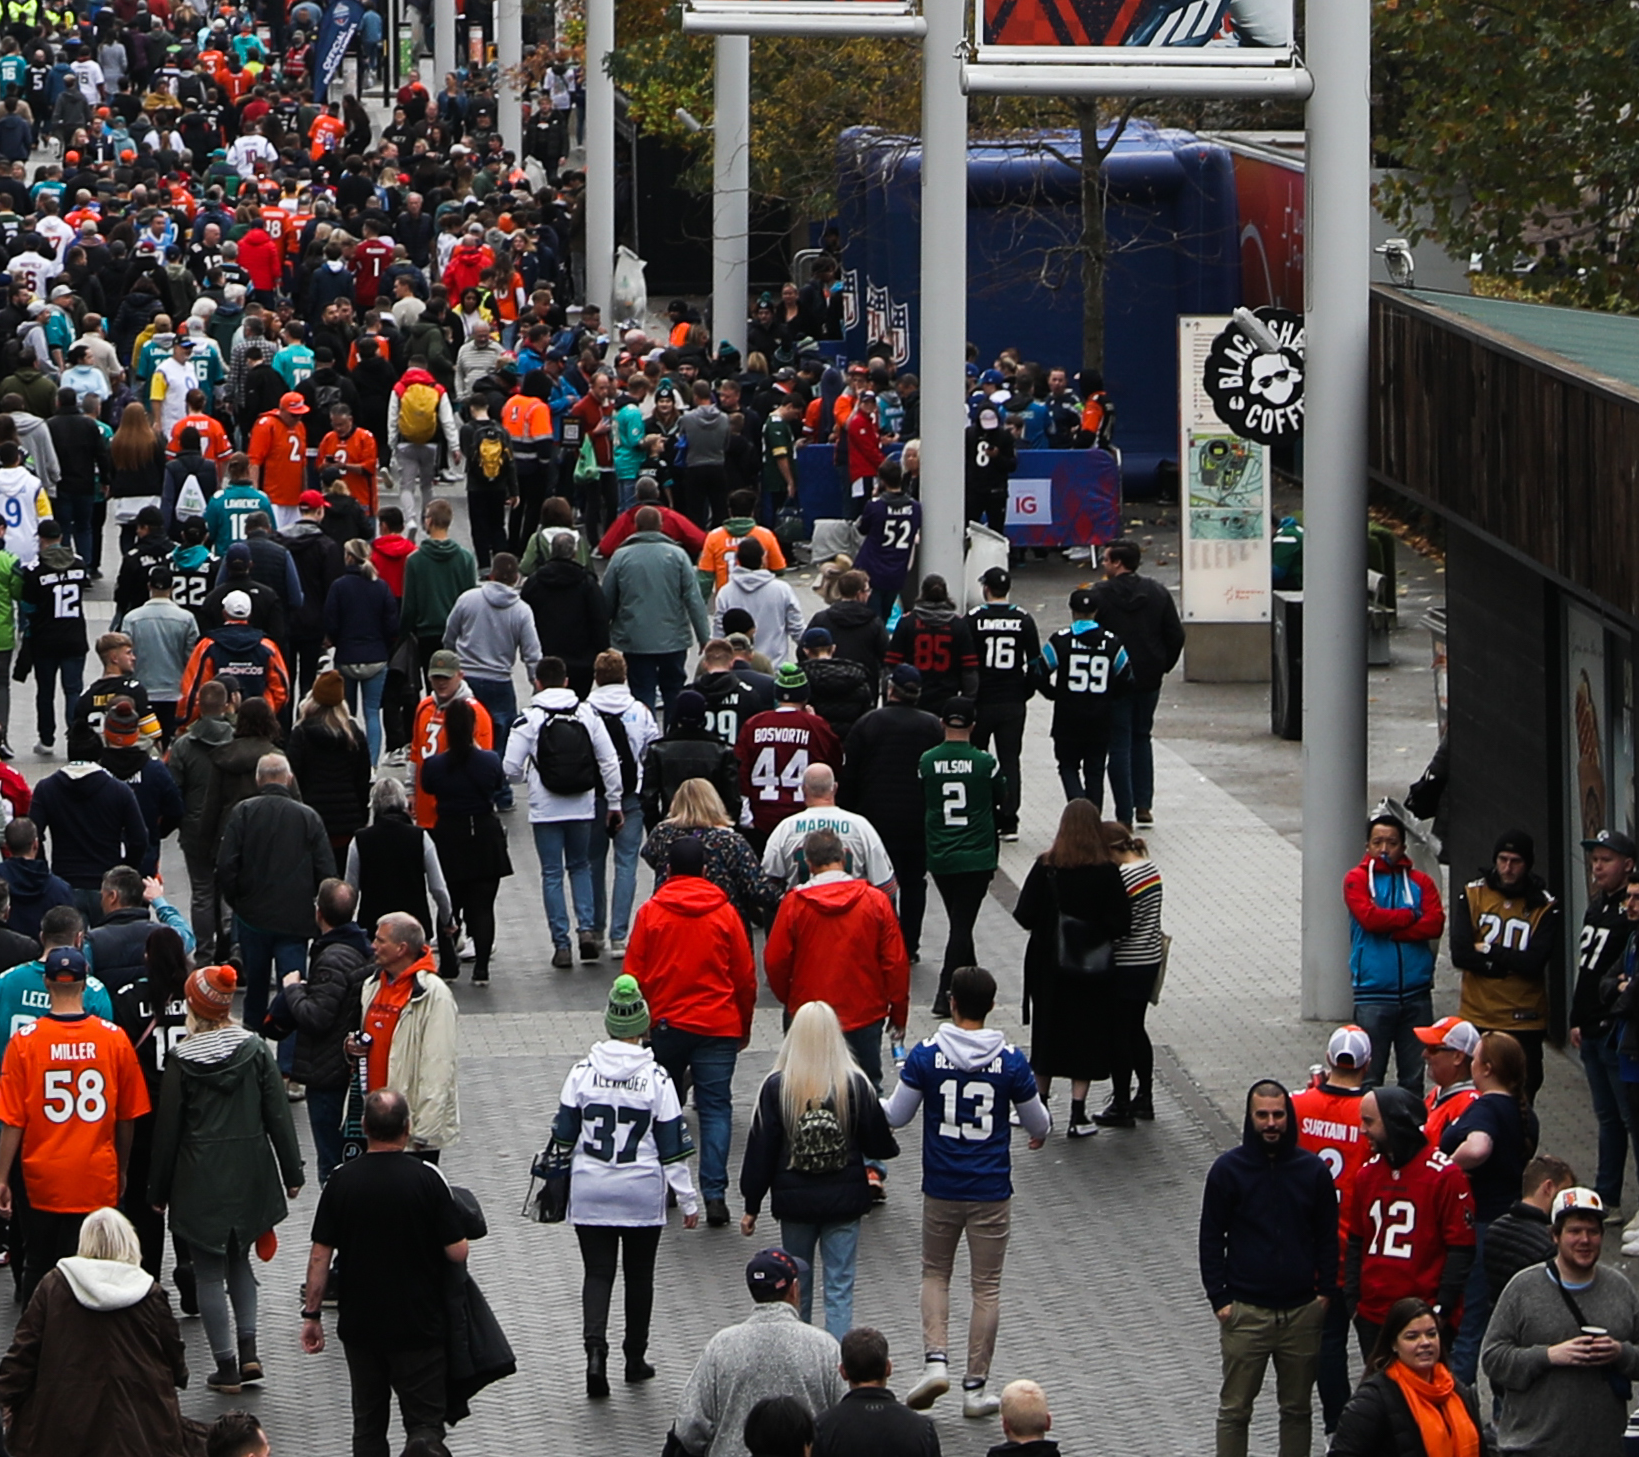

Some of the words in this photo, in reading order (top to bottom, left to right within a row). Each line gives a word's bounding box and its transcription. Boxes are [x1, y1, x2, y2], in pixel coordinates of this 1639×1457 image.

[1218, 334, 1259, 389] BLAC
[288, 435, 302, 462] 2
[976, 439, 990, 468] 8
[4, 497, 22, 528] 9
[1014, 496, 1038, 515] IG
[882, 520, 912, 549] 52
[52, 583, 82, 619] 12
[171, 575, 207, 606] 22
[976, 618, 1022, 632] LAWRENCE
[913, 633, 953, 672] 85
[984, 636, 1015, 670] 16
[1067, 654, 1110, 693] 59
[753, 727, 810, 745] BOSWORTH
[750, 746, 810, 803] 44
[933, 759, 973, 776] WILSON
[941, 781, 969, 826] 2
[1579, 925, 1611, 971] 27
[50, 1043, 96, 1061] MILLER
[43, 1068, 108, 1124] 58
[938, 1079, 995, 1142] 13
[582, 1102, 651, 1165] 37
[1300, 1116, 1348, 1142] SURTAIN
[1367, 1199, 1415, 1260] 12
